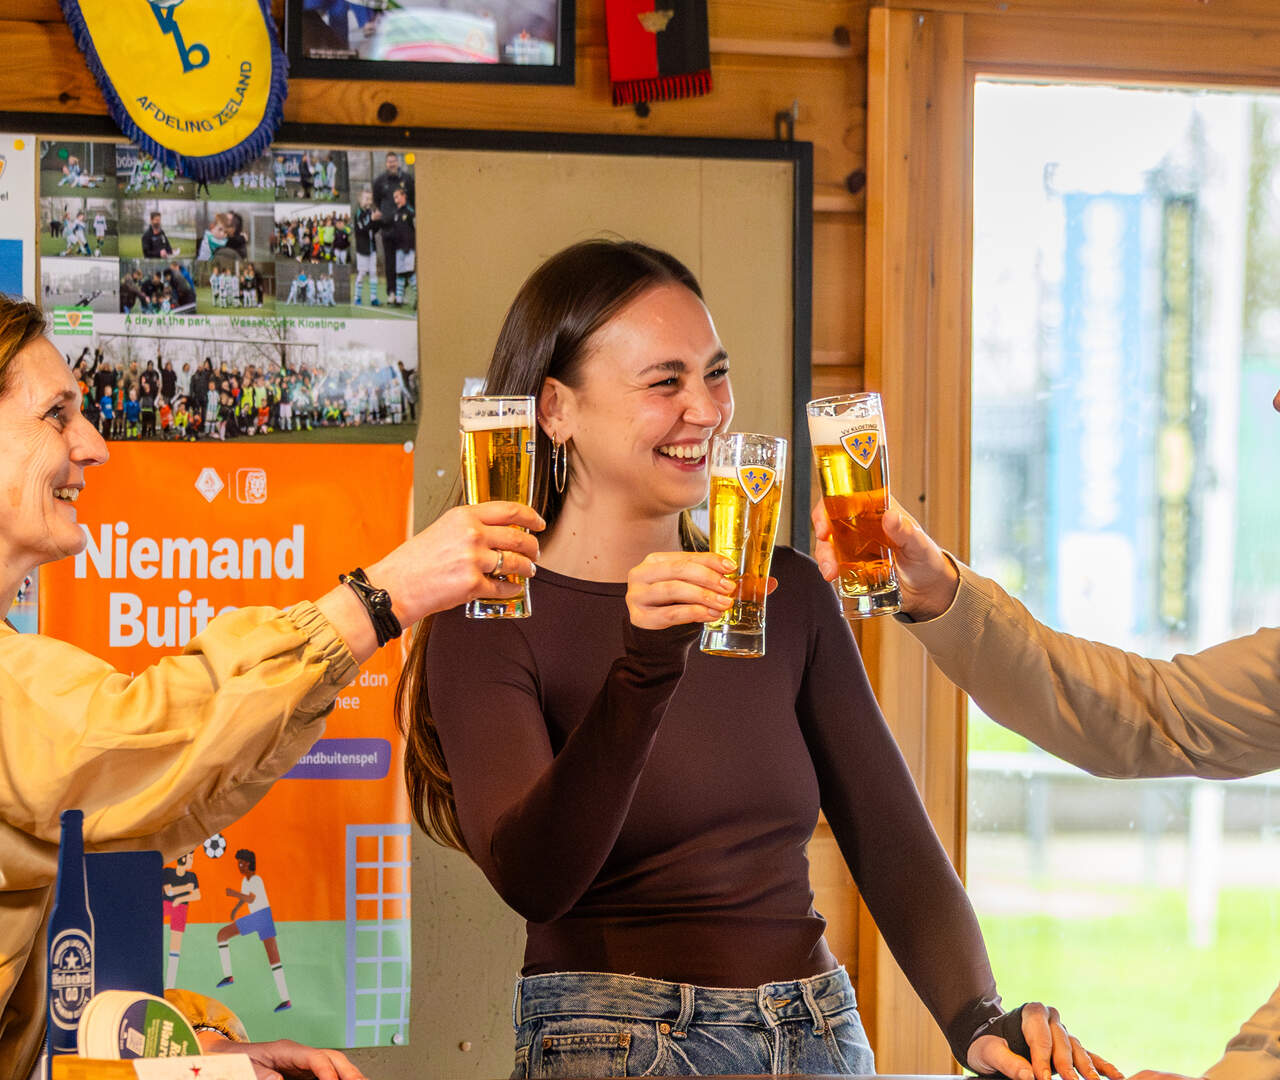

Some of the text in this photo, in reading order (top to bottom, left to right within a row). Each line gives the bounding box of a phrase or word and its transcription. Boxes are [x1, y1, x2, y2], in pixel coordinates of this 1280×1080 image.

[136, 61, 252, 133] AFDELING ZEELAND
[135, 317, 153, 327] day
[187, 316, 211, 327] park
[74, 521, 305, 580] Niemand
[359, 670, 389, 687] dan
